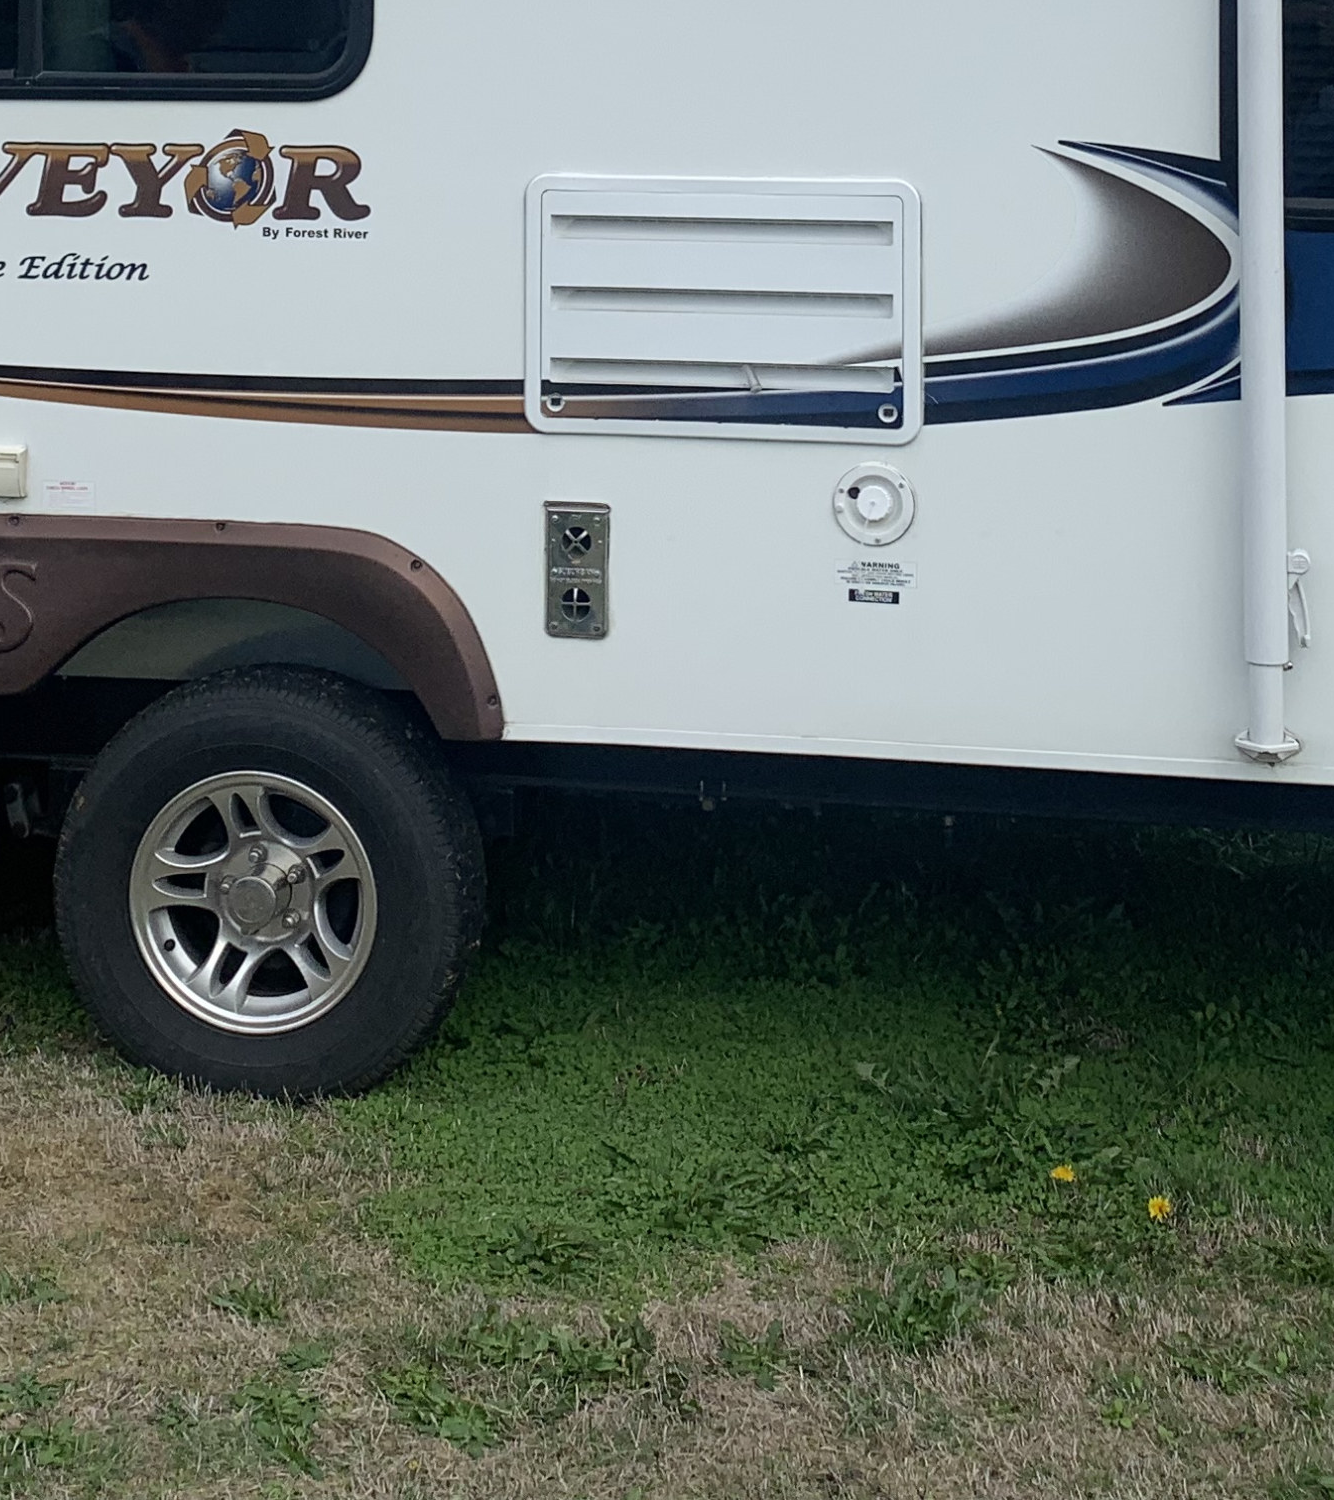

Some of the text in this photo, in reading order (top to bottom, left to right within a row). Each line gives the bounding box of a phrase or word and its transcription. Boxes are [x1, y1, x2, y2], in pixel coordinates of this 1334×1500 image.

[262, 227, 369, 240] By Forest River
[18, 253, 150, 281] Edition
